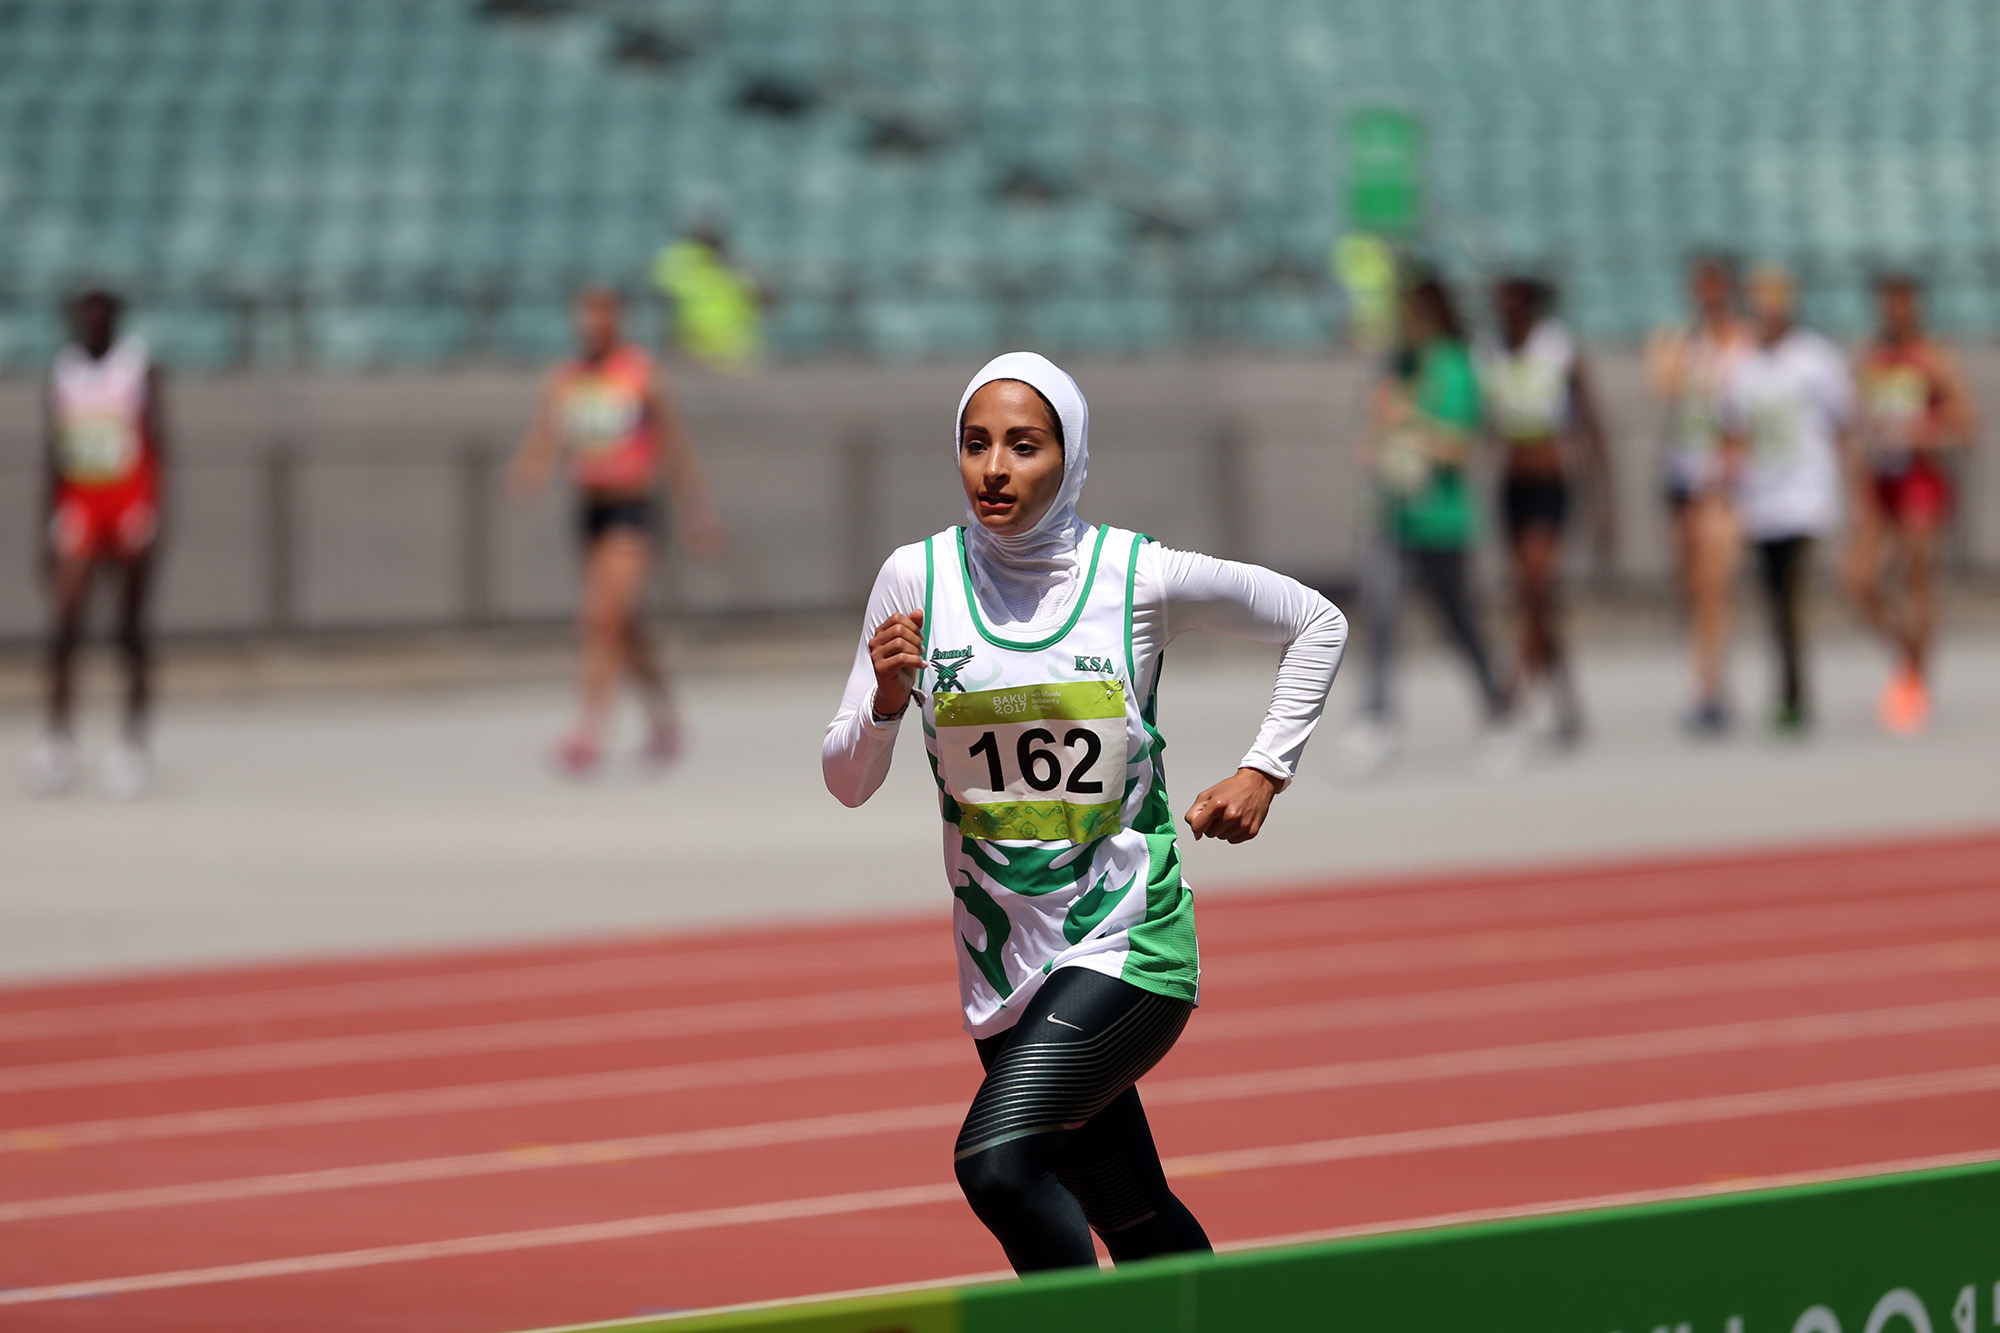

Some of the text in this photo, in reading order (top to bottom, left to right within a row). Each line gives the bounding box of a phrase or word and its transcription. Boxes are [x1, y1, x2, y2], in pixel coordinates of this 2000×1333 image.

[1074, 656, 1114, 674] KSA
[992, 693, 1027, 706] BAKU
[994, 702, 1027, 715] 2017
[968, 727, 1103, 794] 162
